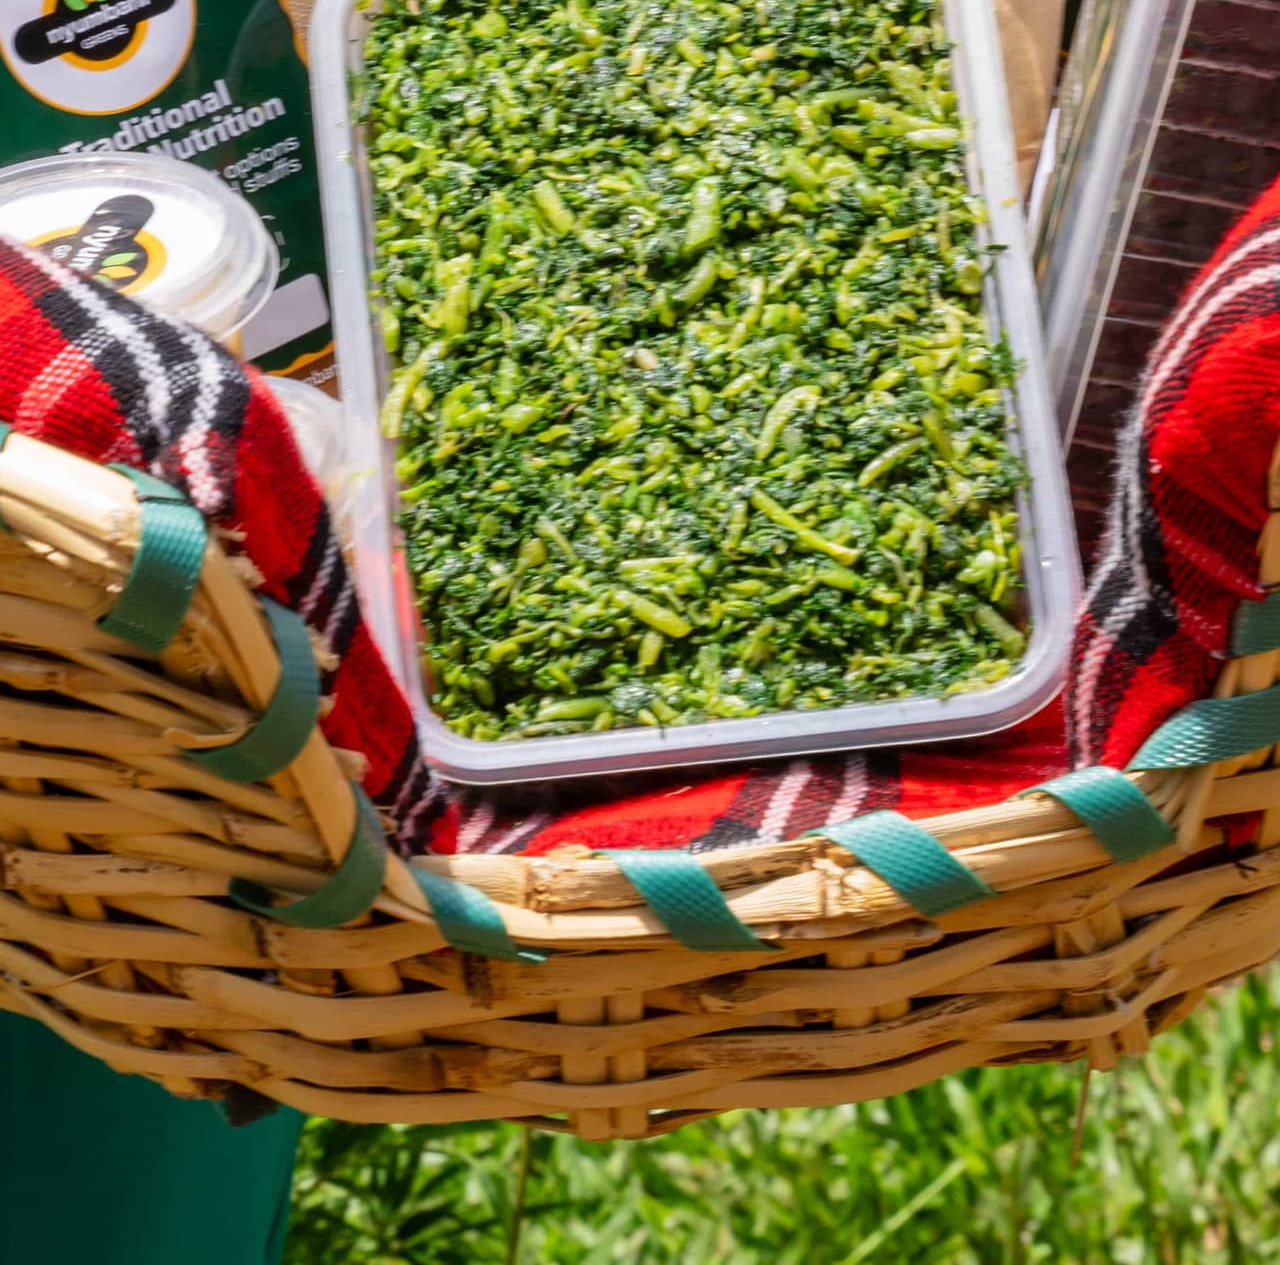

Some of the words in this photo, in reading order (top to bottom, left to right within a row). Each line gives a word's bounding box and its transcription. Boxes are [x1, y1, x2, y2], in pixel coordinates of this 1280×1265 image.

[58, 78, 233, 154] Traditional
[147, 96, 287, 160] Nutrition
[223, 136, 301, 180] options
